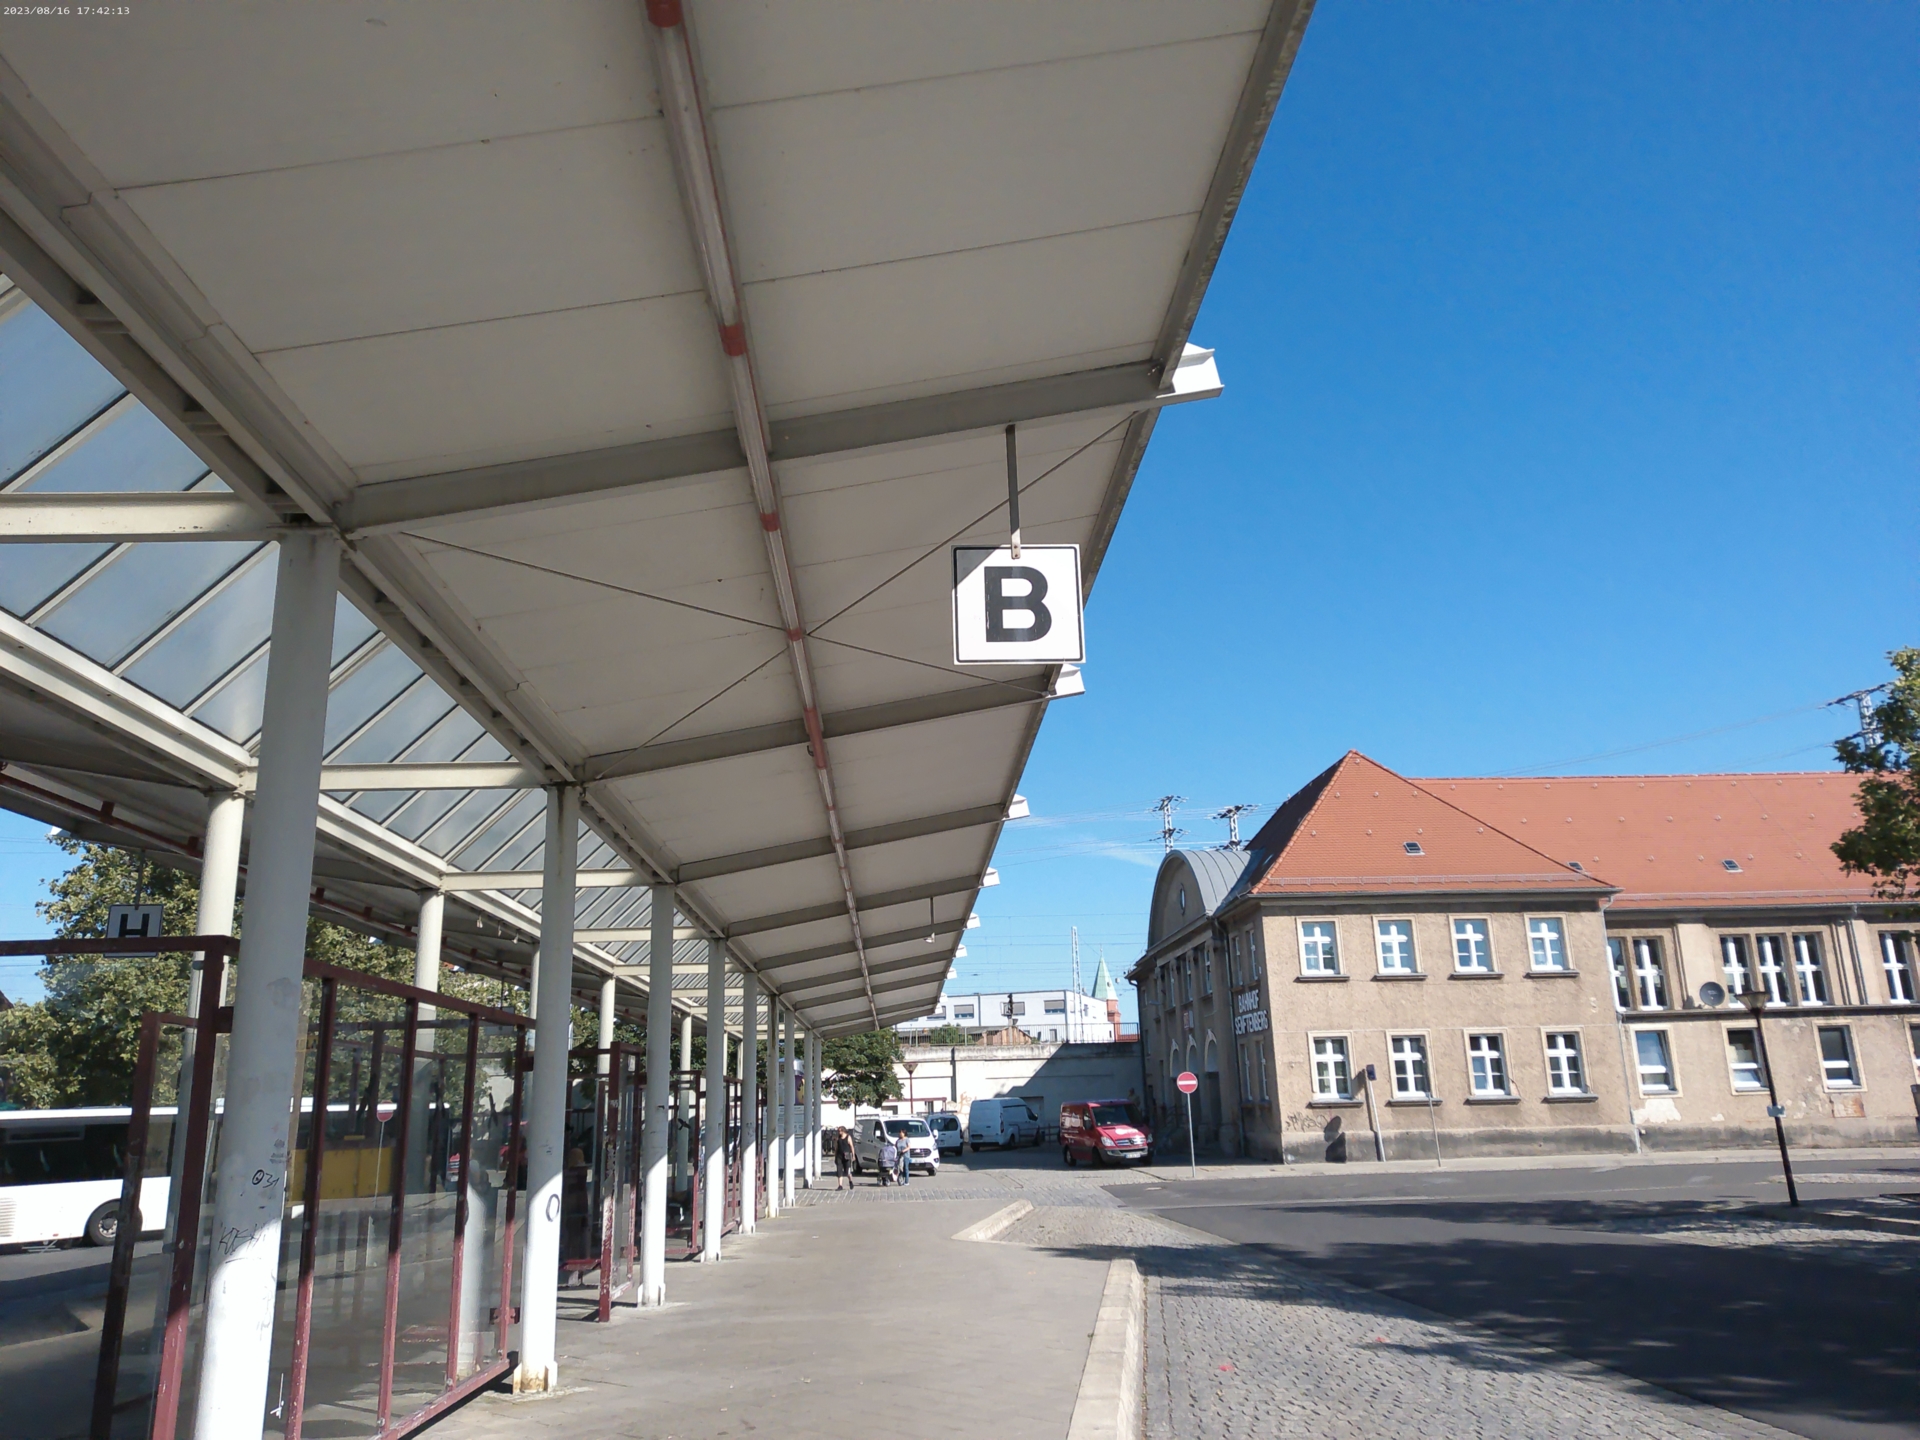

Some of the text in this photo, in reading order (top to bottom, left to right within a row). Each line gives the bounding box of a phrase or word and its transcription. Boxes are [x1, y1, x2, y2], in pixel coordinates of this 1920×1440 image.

[984, 566, 1052, 642] B
[1238, 989, 1259, 1013] BAHNHOF
[1234, 1010, 1268, 1035] SENFTENBERG
